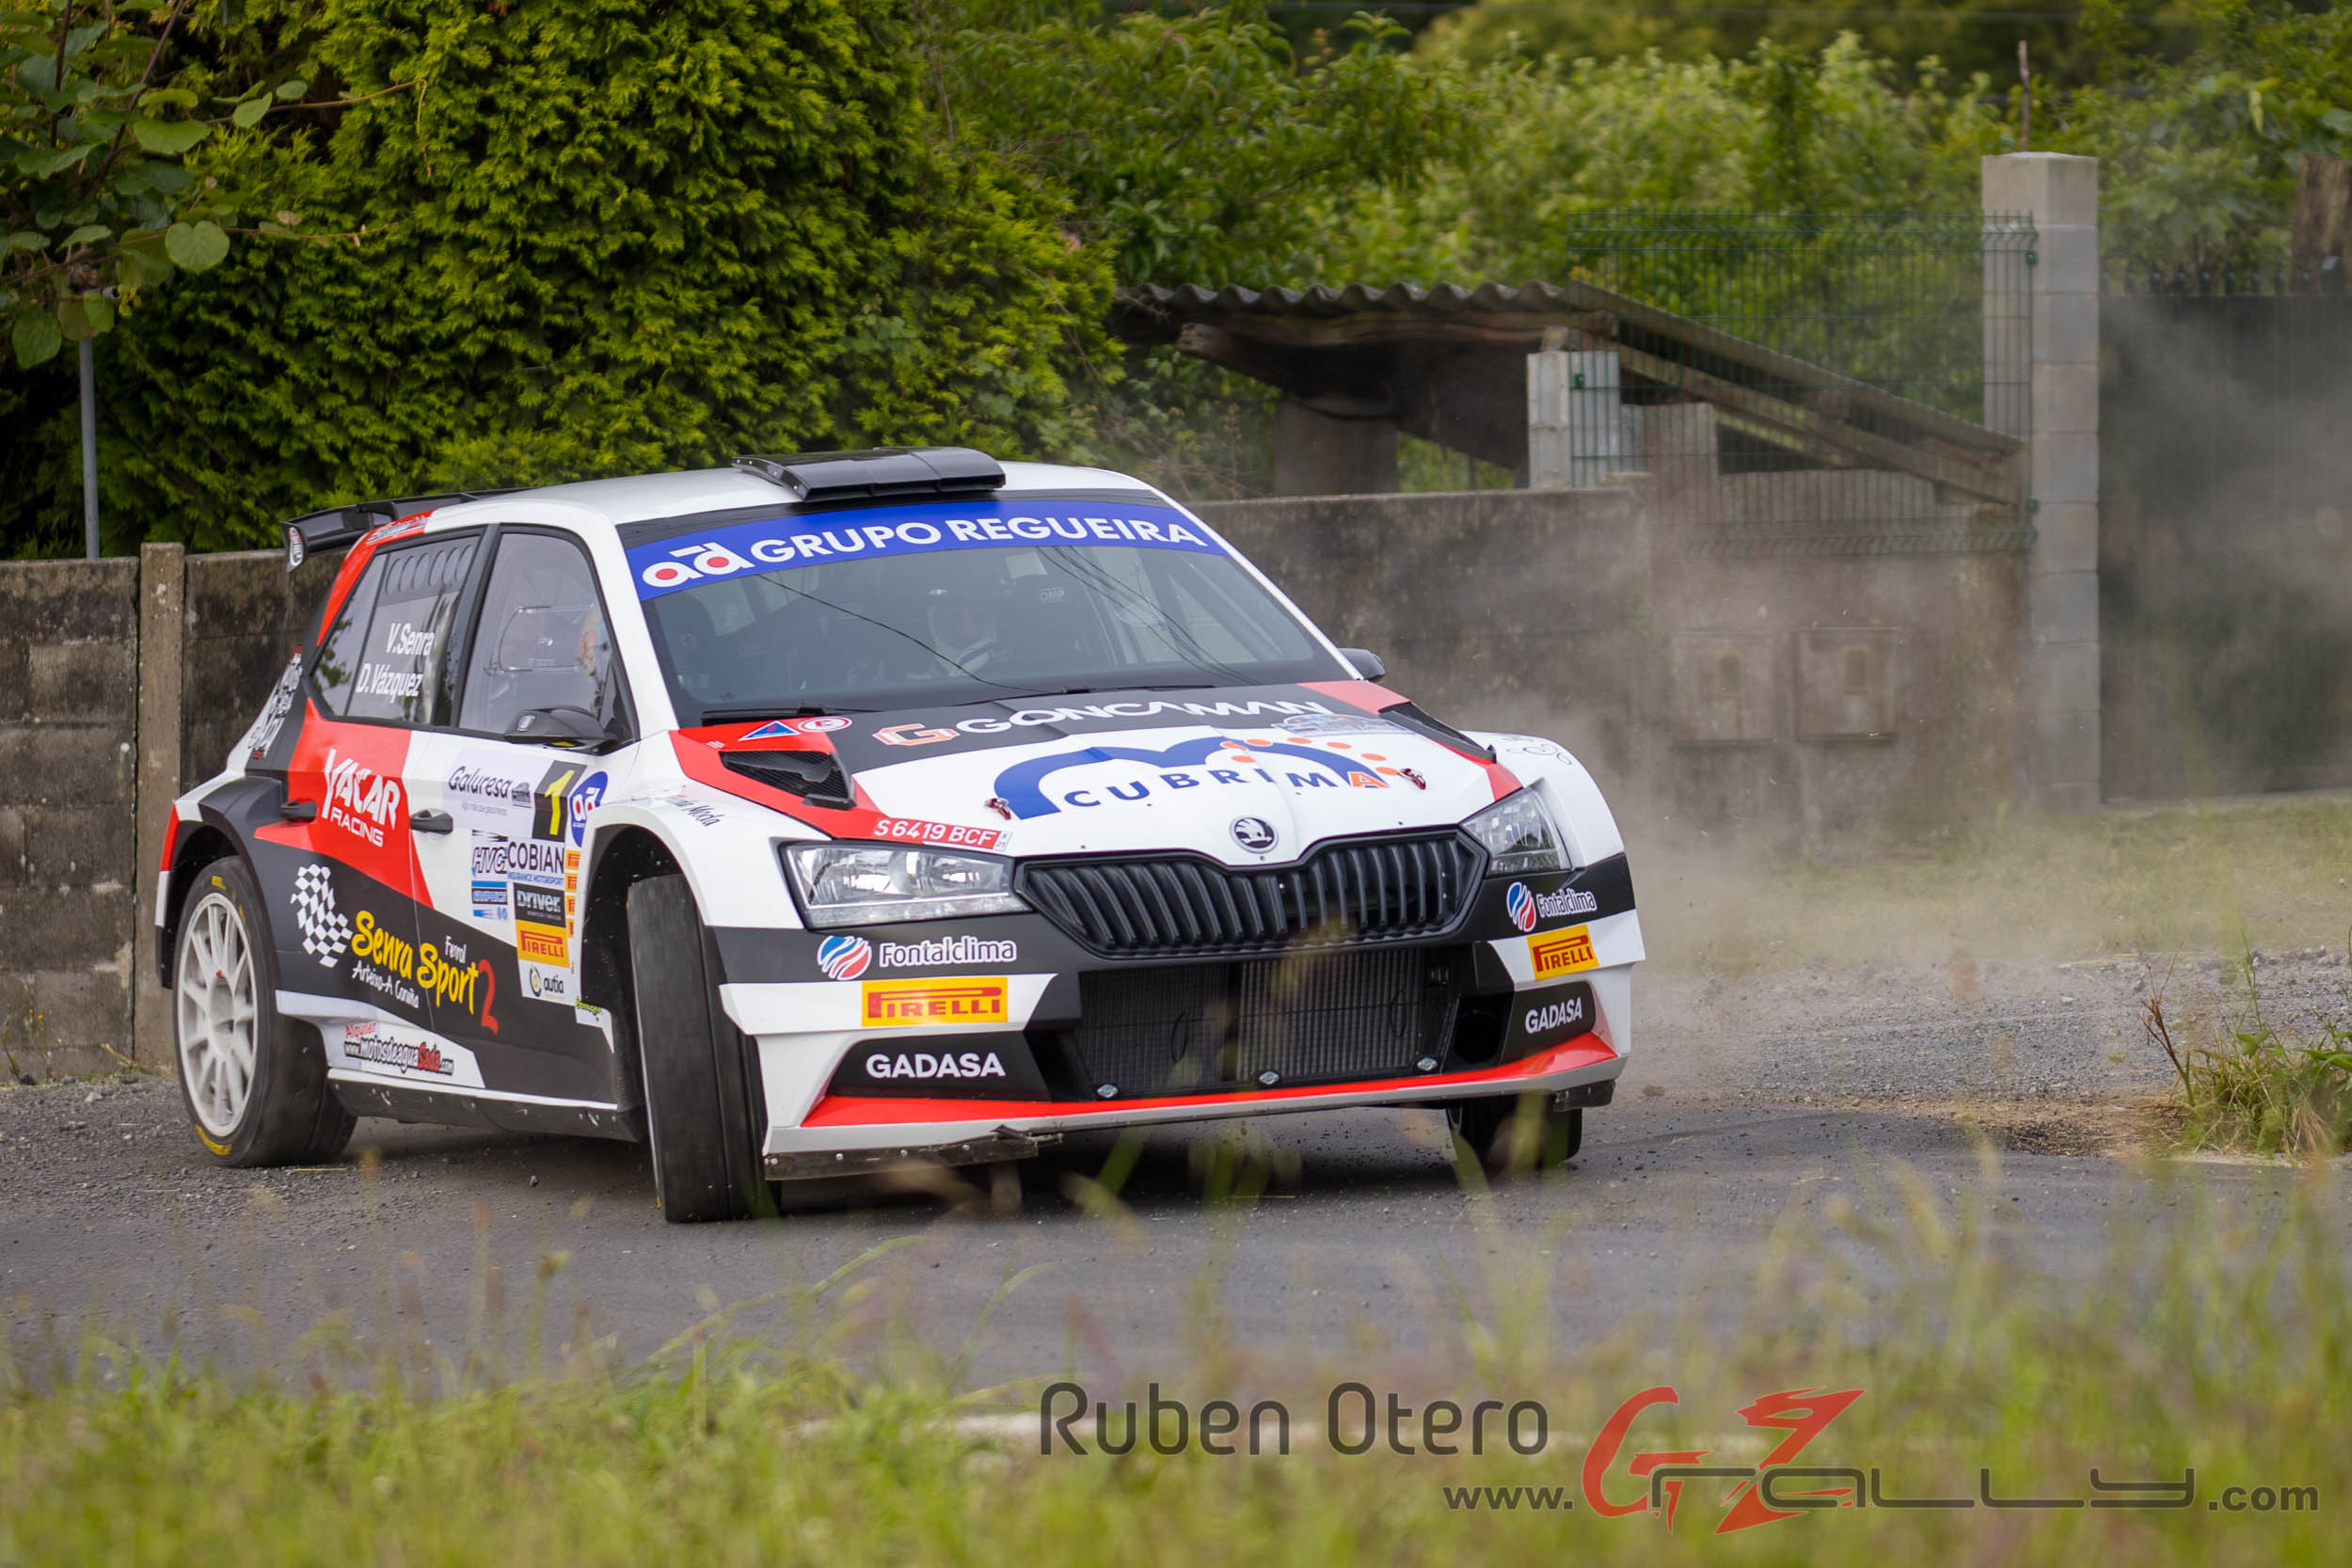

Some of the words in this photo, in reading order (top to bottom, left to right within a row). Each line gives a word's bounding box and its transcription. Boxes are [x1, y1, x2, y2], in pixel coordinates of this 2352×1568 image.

[751, 522, 942, 562] GRUPO
[945, 516, 1208, 547] REGUEIRA
[387, 623, 436, 656] V.Senra
[956, 701, 1337, 733] GONCAMAN
[322, 748, 401, 831] YACAR
[449, 766, 512, 799] Galuresa
[1063, 768, 1390, 807] CUBRIMA
[545, 769, 575, 835] 1
[330, 806, 384, 847] RACING
[874, 820, 891, 835] S
[892, 821, 946, 839] 6419
[948, 827, 996, 845] BCF
[508, 841, 564, 874] COBIAN
[1536, 888, 1597, 918] Fontalclima
[520, 930, 564, 958] PIRELLI
[880, 936, 1017, 968] Fontalclima
[1533, 935, 1594, 973] PIRELLI
[351, 910, 413, 980] Senra
[416, 942, 479, 1015] Sport
[479, 958, 499, 1035] 2
[867, 987, 1002, 1019] PIRELLI
[1525, 997, 1582, 1034] GADASA
[866, 1052, 1007, 1078] GADASA
